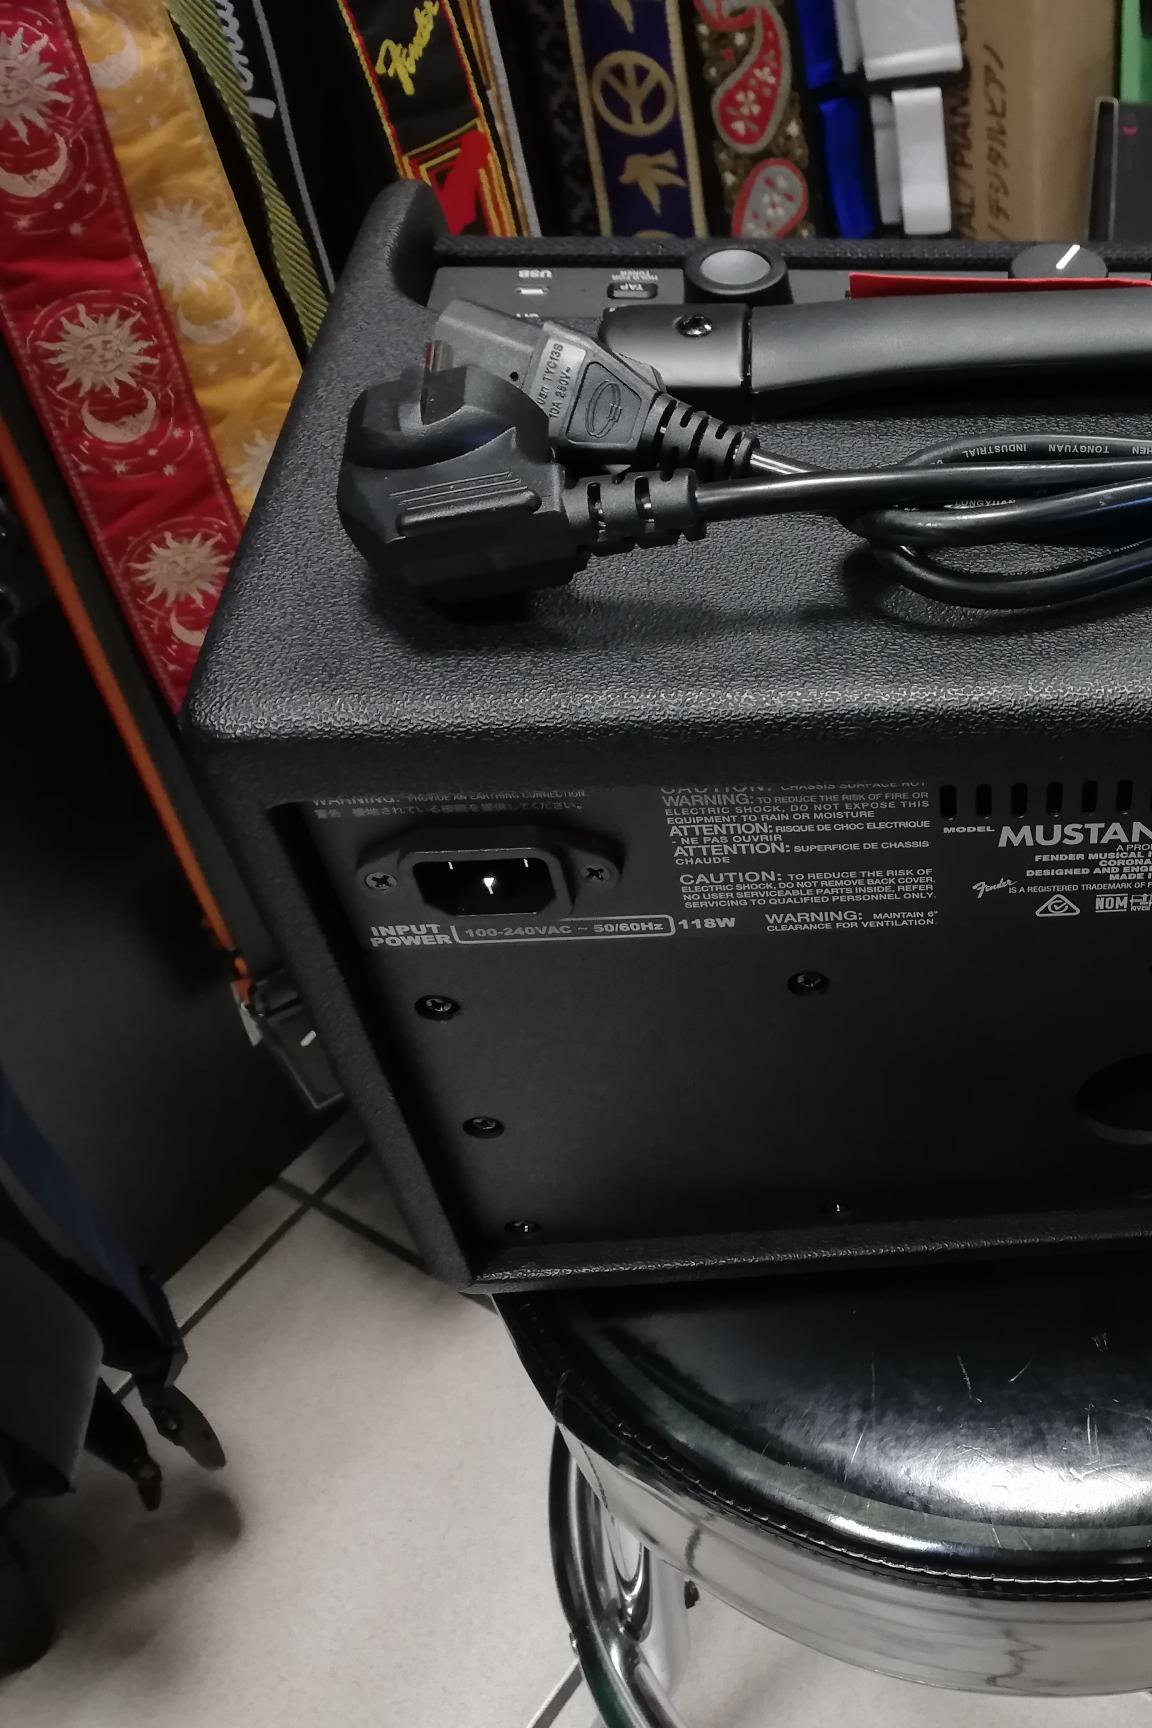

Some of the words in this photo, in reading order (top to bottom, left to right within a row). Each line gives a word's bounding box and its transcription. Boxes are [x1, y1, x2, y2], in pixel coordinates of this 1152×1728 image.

[518, 269, 552, 279] USB
[619, 283, 645, 292] TAP
[962, 444, 1027, 458] INDUSTRIAL
[1048, 444, 1110, 454] TONGYUAN
[661, 793, 755, 807] WARNING:
[774, 795, 817, 804] REDUCE
[820, 794, 840, 803] THE
[841, 793, 866, 802] RISK
[867, 793, 881, 801] OF
[884, 792, 910, 801] FIRE
[911, 791, 929, 800] OR
[664, 806, 730, 816] ELECTRIC
[735, 804, 786, 814] SHOCK,
[790, 804, 809, 812] DO
[813, 803, 840, 812] NOT
[844, 801, 896, 810] EXPOSE
[900, 800, 930, 808] THIS
[666, 815, 738, 825] EQUIPMENT
[739, 814, 758, 823] TO
[760, 813, 790, 822] RAIN
[792, 812, 811, 821] OR
[813, 810, 876, 820] MOISTURE
[669, 822, 773, 837] ATTENTION:
[775, 824, 815, 833] RISQUE
[816, 824, 832, 832] DE
[833, 822, 864, 831] CHOC
[866, 820, 931, 830] ELECTRIQUE
[943, 826, 996, 834] MODEL
[680, 837, 702, 845] NE
[703, 835, 729, 844] PAS
[732, 834, 783, 843] OUVRIR
[673, 842, 791, 857] ATTENTION:
[793, 842, 861, 853] SUPERFICIE
[862, 842, 879, 850] DE
[880, 840, 930, 849] CHASSIS
[1116, 844, 1124, 852] A
[675, 856, 730, 866] CHAUDE
[1034, 853, 1086, 862] FENDER
[1087, 851, 1145, 861] MUSICAL
[679, 870, 782, 885] CAUTION:
[787, 873, 804, 881] TO
[807, 871, 858, 880] REDUCE
[860, 870, 883, 878] THE
[886, 869, 913, 877] RISK
[916, 868, 933, 876] OF
[1026, 867, 1091, 877] DESIGNED
[1092, 866, 1120, 874] AND
[1108, 872, 1145, 881] MADE
[681, 884, 734, 893] ELECTRIC
[735, 882, 777, 891] SHOCK,
[796, 880, 819, 889] NOT
[820, 879, 865, 888] REMOVE
[866, 877, 896, 886] BACK
[897, 876, 936, 884] COVER.
[971, 877, 1019, 899] Fender
[1008, 886, 1017, 894] IS
[1018, 885, 1026, 893] A
[1027, 884, 1079, 893] REGISTERED
[1081, 882, 1132, 892] TRADEMARK
[1134, 881, 1146, 889] OF
[683, 893, 700, 901] NO
[703, 892, 735, 900] USER
[736, 888, 814, 899] SERVICEABLE
[815, 887, 853, 896] PARTS
[897, 884, 934, 892] REFER
[684, 899, 748, 909] SERVICING
[749, 898, 766, 906] TO
[768, 896, 830, 906] QUALIFIED
[831, 893, 901, 903] PERSONNEL
[902, 891, 937, 899] ONLY.
[1095, 895, 1128, 911] NOM
[678, 917, 736, 930] 118W
[764, 910, 863, 924] WARNING:
[872, 911, 924, 920] MAINTAIN
[370, 923, 441, 936] INPUT
[465, 924, 572, 938] 100-240VAC
[593, 920, 664, 933] 50/60Hz
[766, 923, 833, 932] CLEARANCE
[835, 921, 859, 929] FOR
[861, 918, 937, 928] VENTILATION.
[371, 934, 453, 948] POWER
